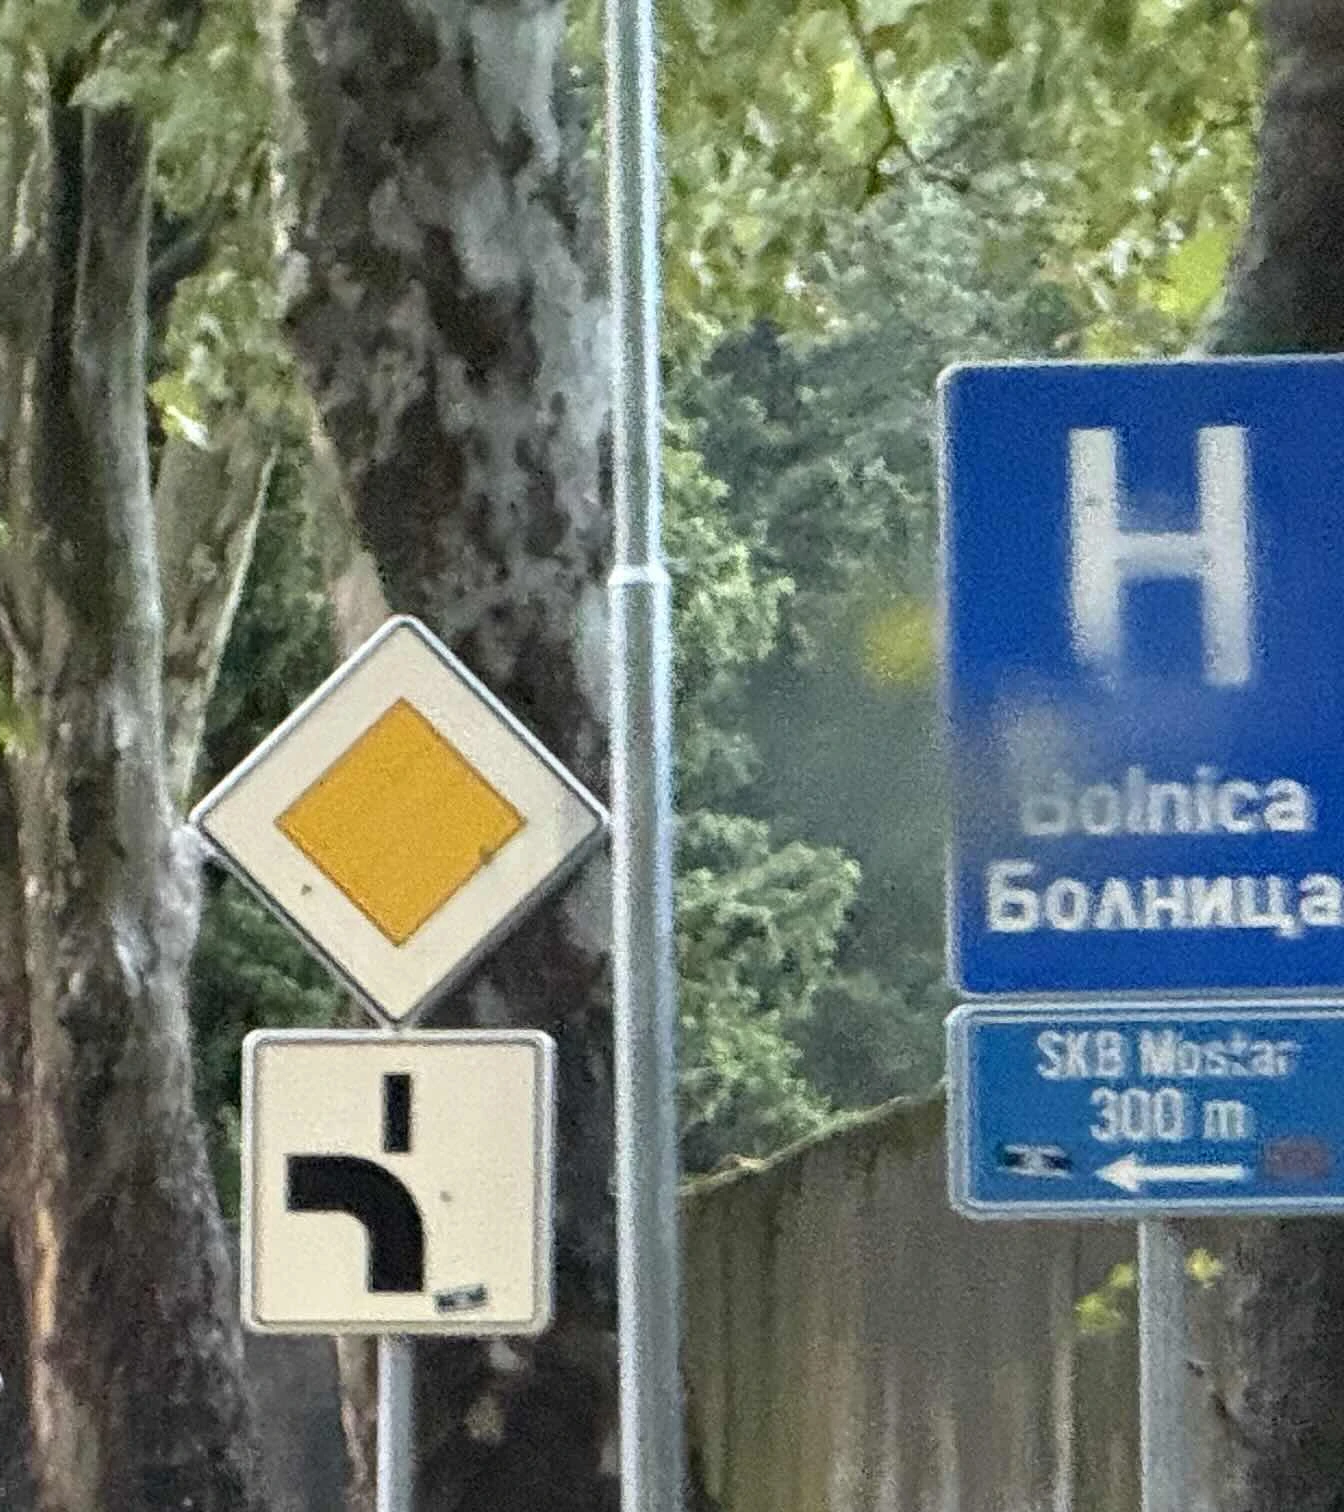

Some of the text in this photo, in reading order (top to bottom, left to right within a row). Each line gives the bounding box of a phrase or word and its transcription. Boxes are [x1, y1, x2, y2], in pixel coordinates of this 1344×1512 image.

[1068, 425, 1253, 688] H
[986, 857, 1344, 938] Болница
[1036, 1027, 1300, 1080] SKB Mostar
[1089, 1086, 1253, 1142] 300 m
